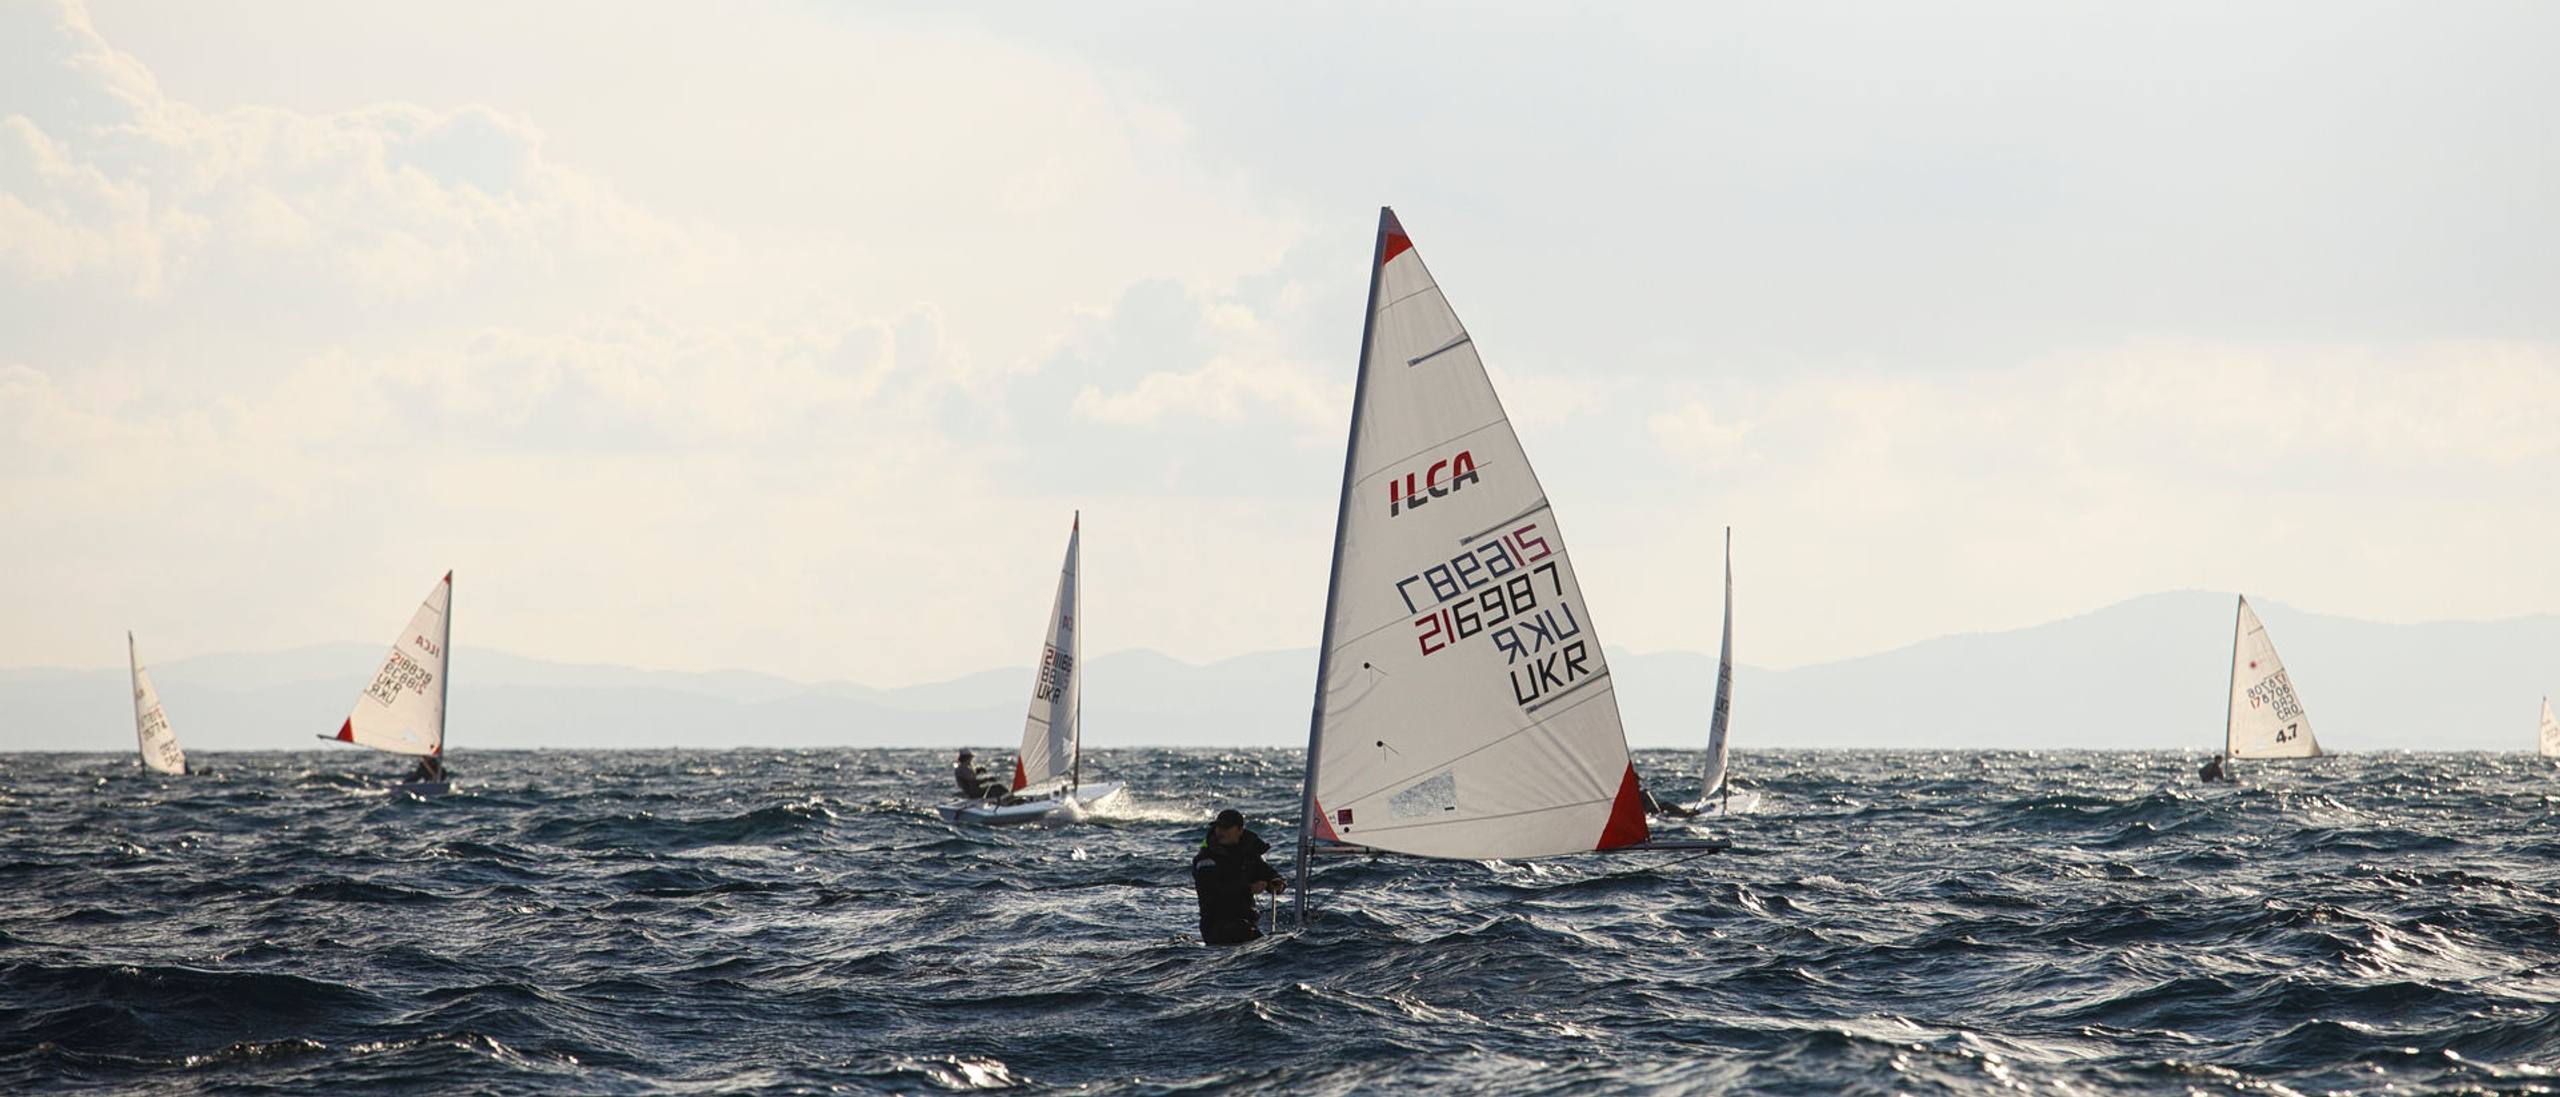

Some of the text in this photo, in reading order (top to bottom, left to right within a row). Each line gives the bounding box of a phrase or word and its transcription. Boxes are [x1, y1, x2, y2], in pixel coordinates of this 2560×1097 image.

[1390, 450, 1480, 518] ILCA
[1415, 560, 1563, 657] 216987
[1037, 683, 1061, 705] UKR
[1510, 639, 1590, 706] UKR
[2276, 722, 2298, 744] 4.7
